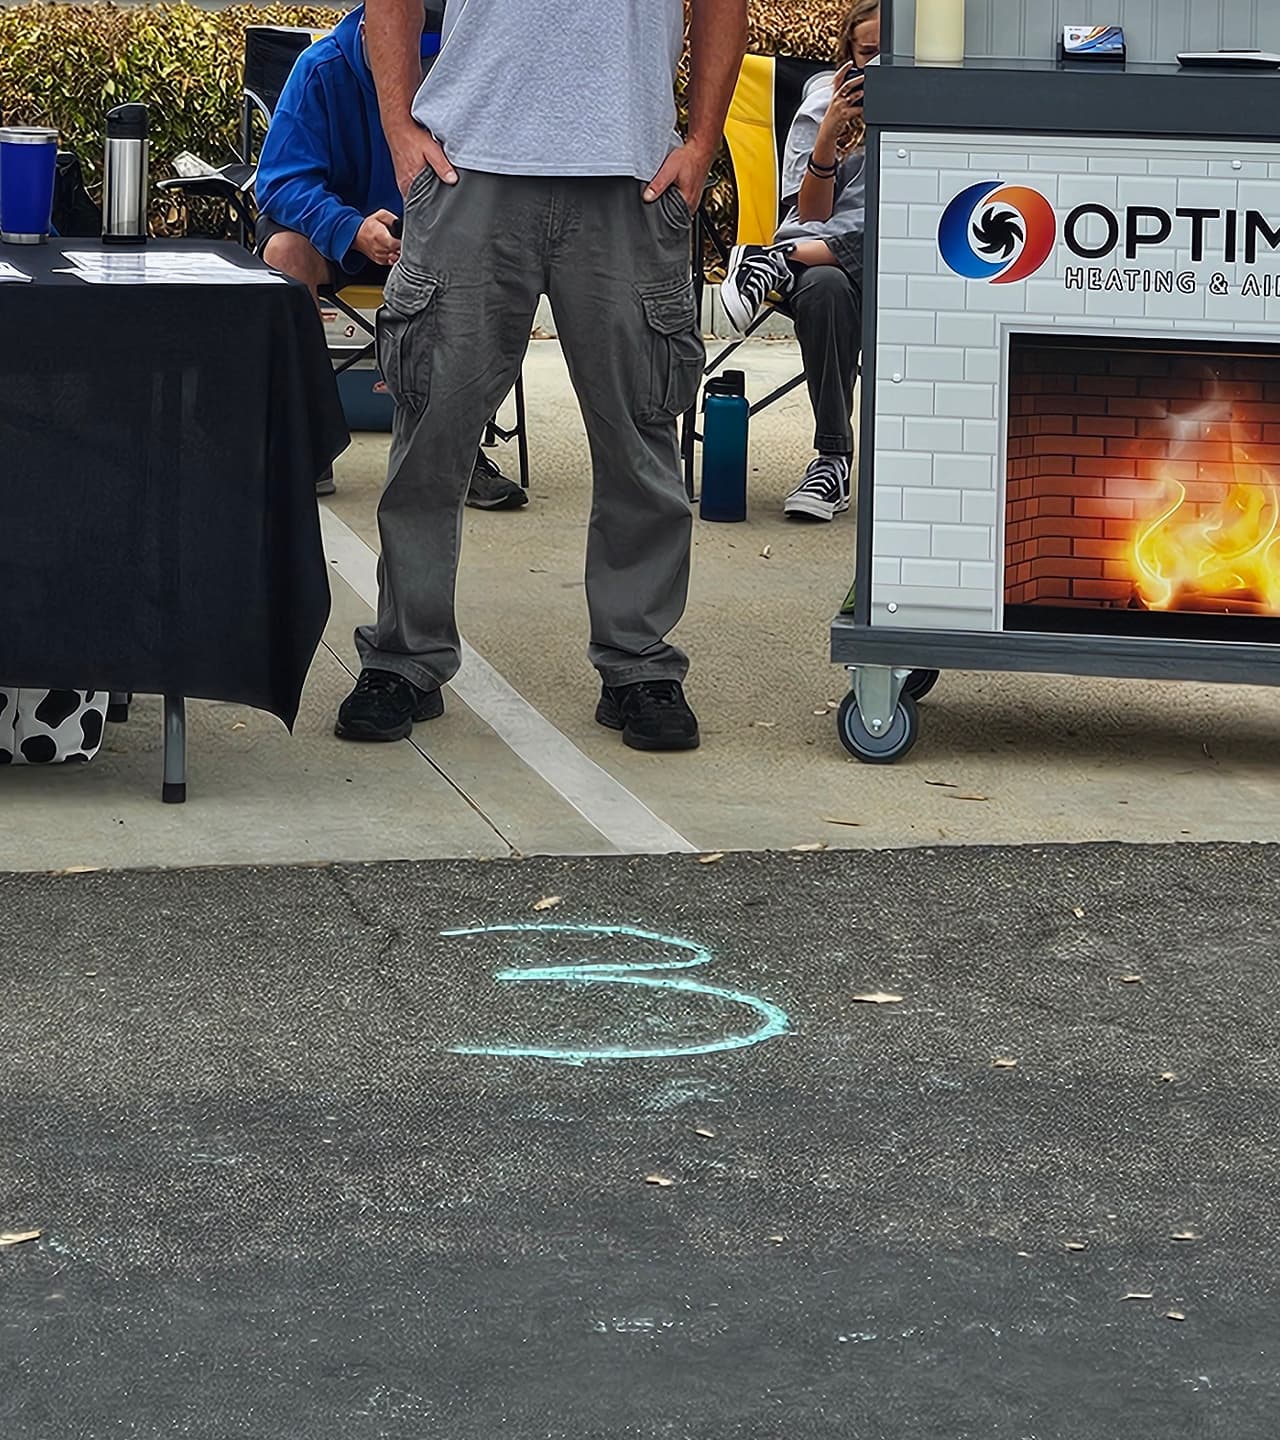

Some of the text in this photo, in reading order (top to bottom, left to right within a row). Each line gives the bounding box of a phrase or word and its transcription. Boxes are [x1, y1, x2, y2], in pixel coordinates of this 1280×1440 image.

[1064, 267, 1195, 294] HEATING
[1209, 272, 1228, 296] &
[439, 922, 793, 1067] 3
